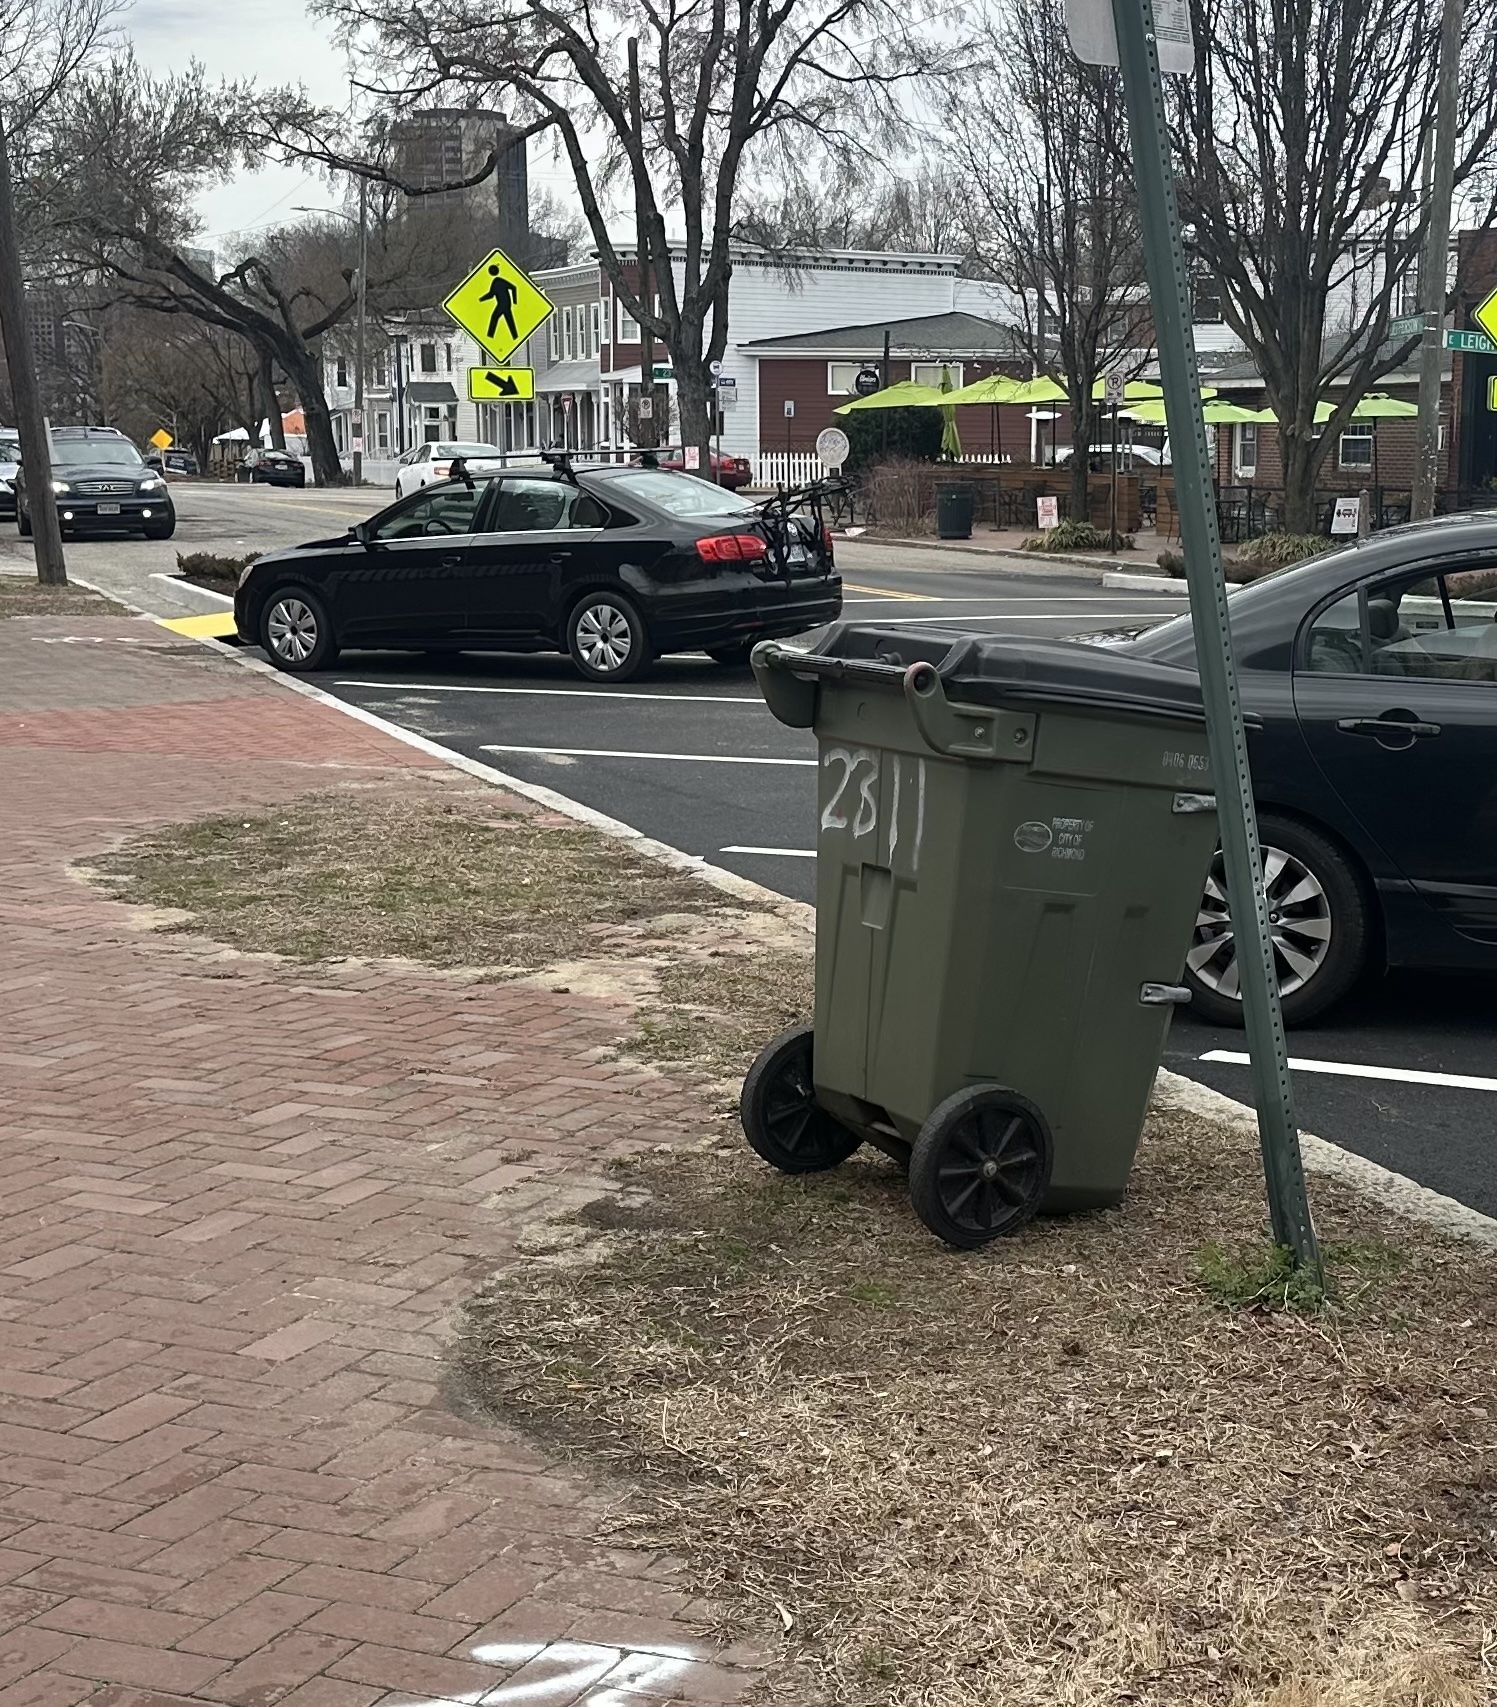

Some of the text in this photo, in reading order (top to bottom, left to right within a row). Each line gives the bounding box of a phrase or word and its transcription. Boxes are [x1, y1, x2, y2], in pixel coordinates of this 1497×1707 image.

[821, 748, 926, 872] 2811
[1058, 833, 1082, 846] CITY OF
